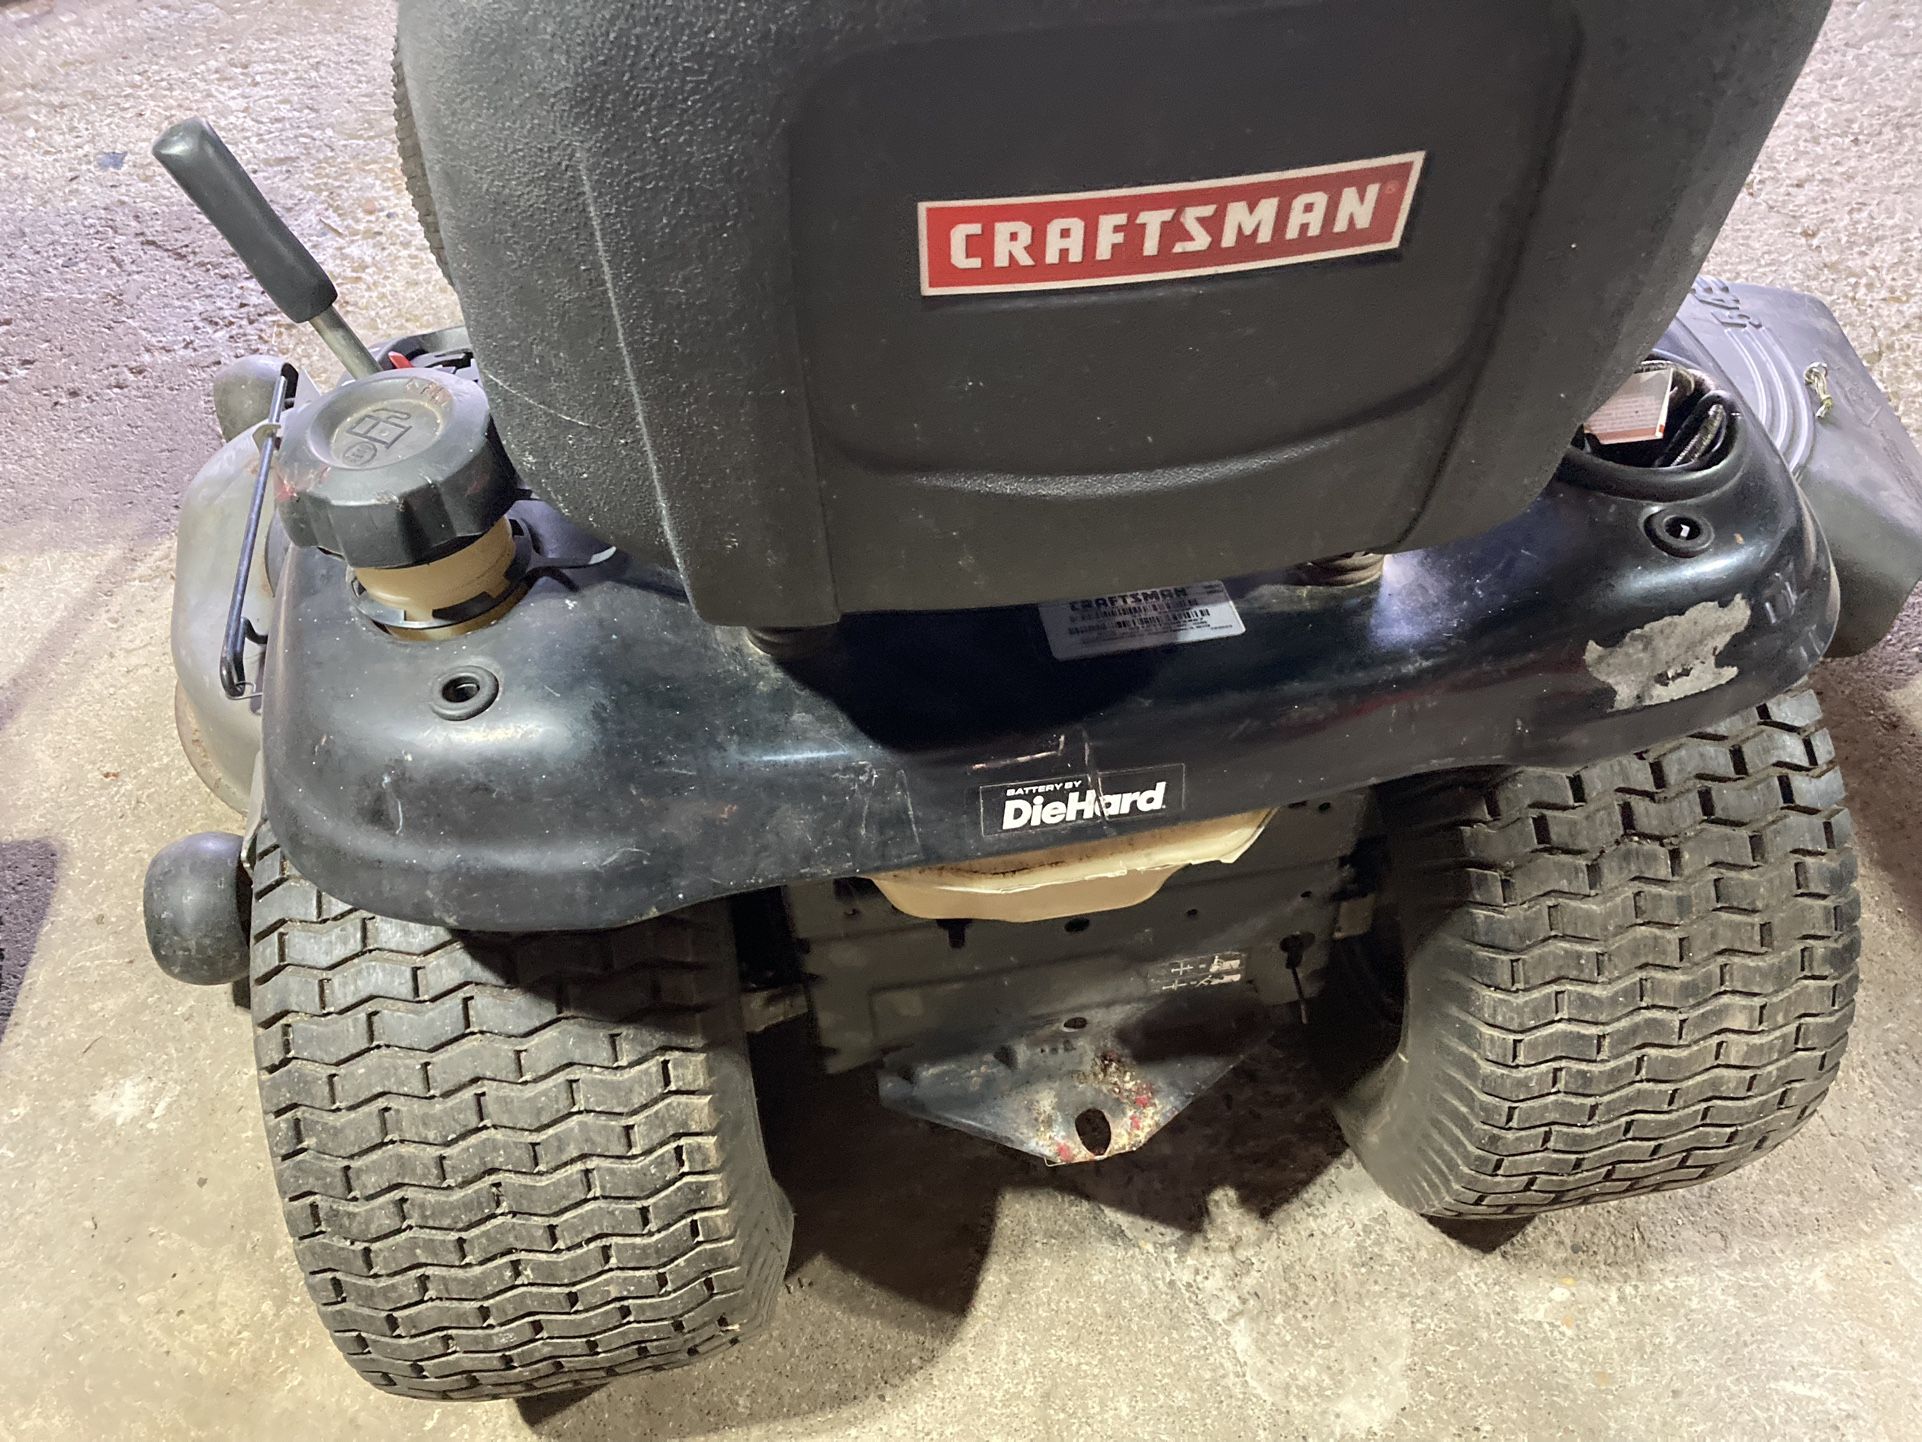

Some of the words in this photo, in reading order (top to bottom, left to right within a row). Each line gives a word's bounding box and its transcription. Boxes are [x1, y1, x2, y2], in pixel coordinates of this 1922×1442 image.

[950, 182, 1381, 268] CRAFTSMAN
[1002, 781, 1166, 830] DieHard
[1006, 782, 1063, 796] BATTERY
[1063, 780, 1082, 790] BY
